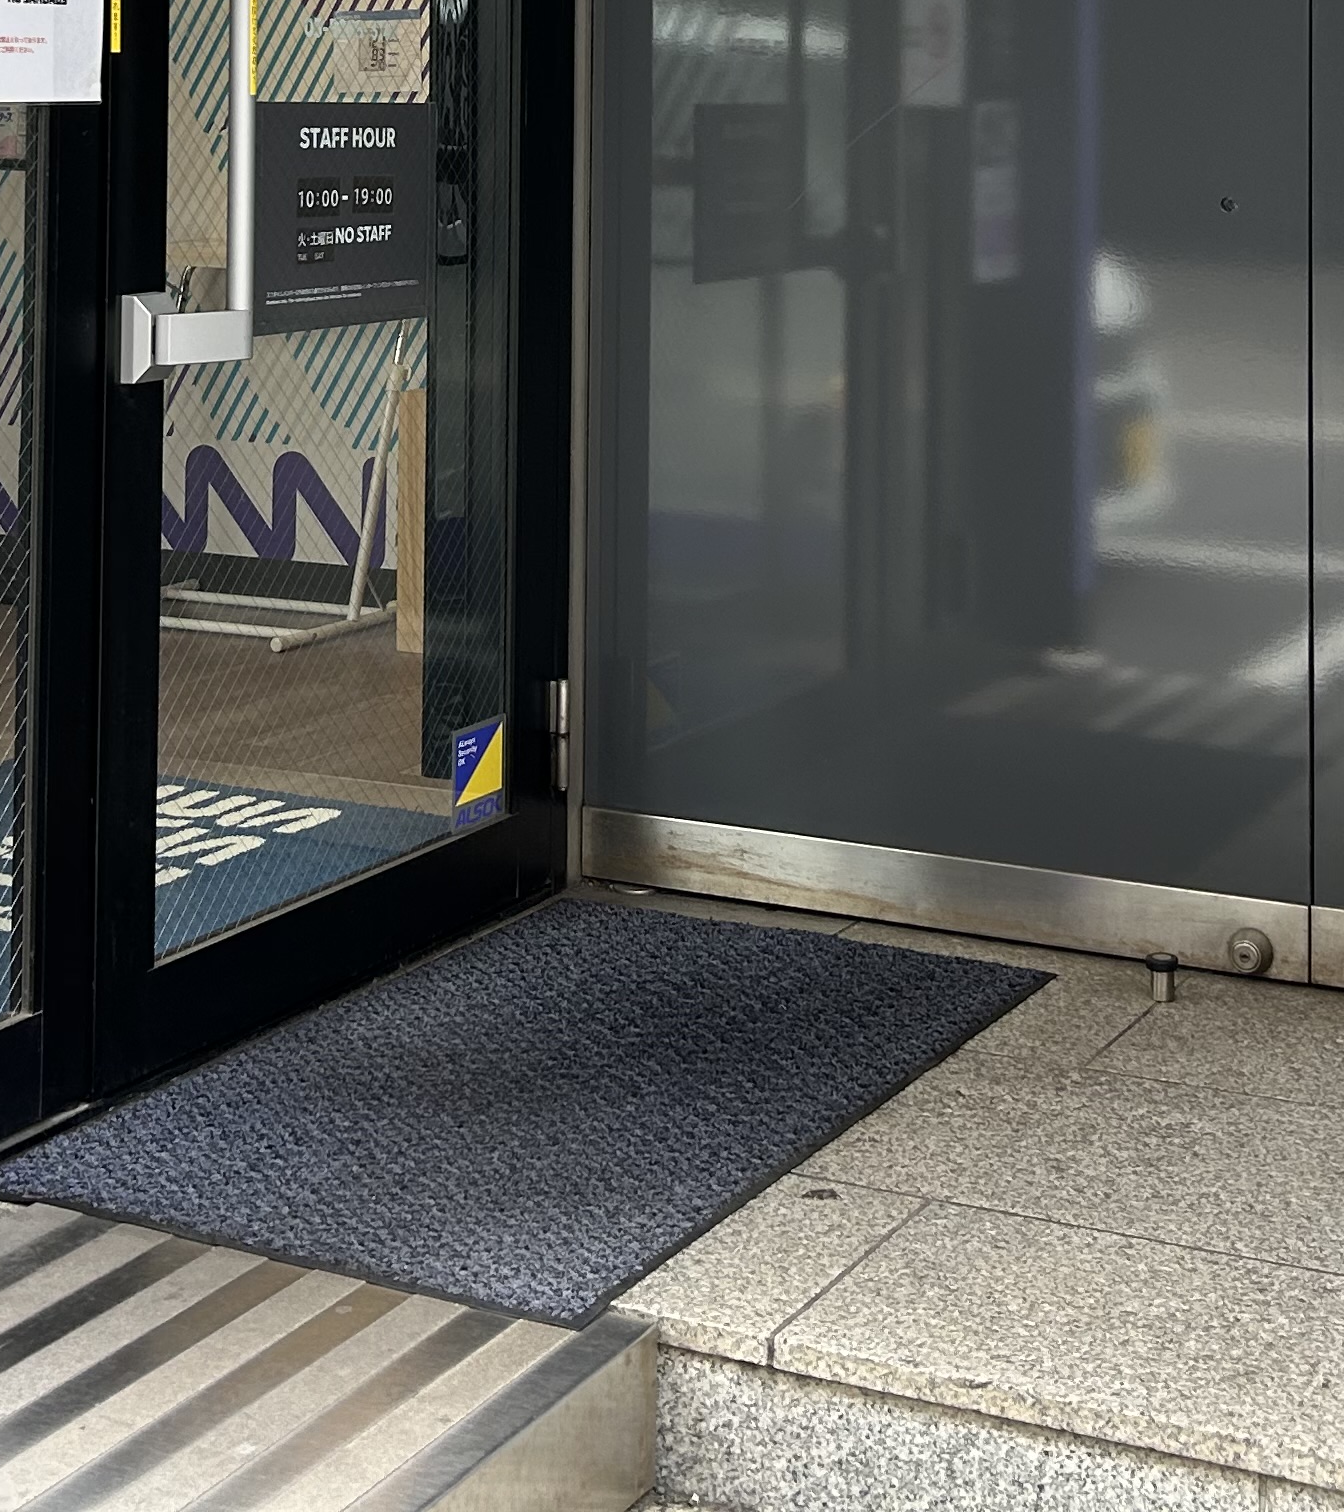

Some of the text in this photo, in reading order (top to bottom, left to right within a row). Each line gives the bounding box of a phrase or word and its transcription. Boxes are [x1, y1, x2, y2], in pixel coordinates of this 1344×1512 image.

[299, 127, 396, 149] STAFF HOUR
[297, 189, 339, 209] 10:00
[353, 187, 393, 205] 19:00
[335, 226, 355, 245] NO
[356, 224, 392, 243] STAFF
